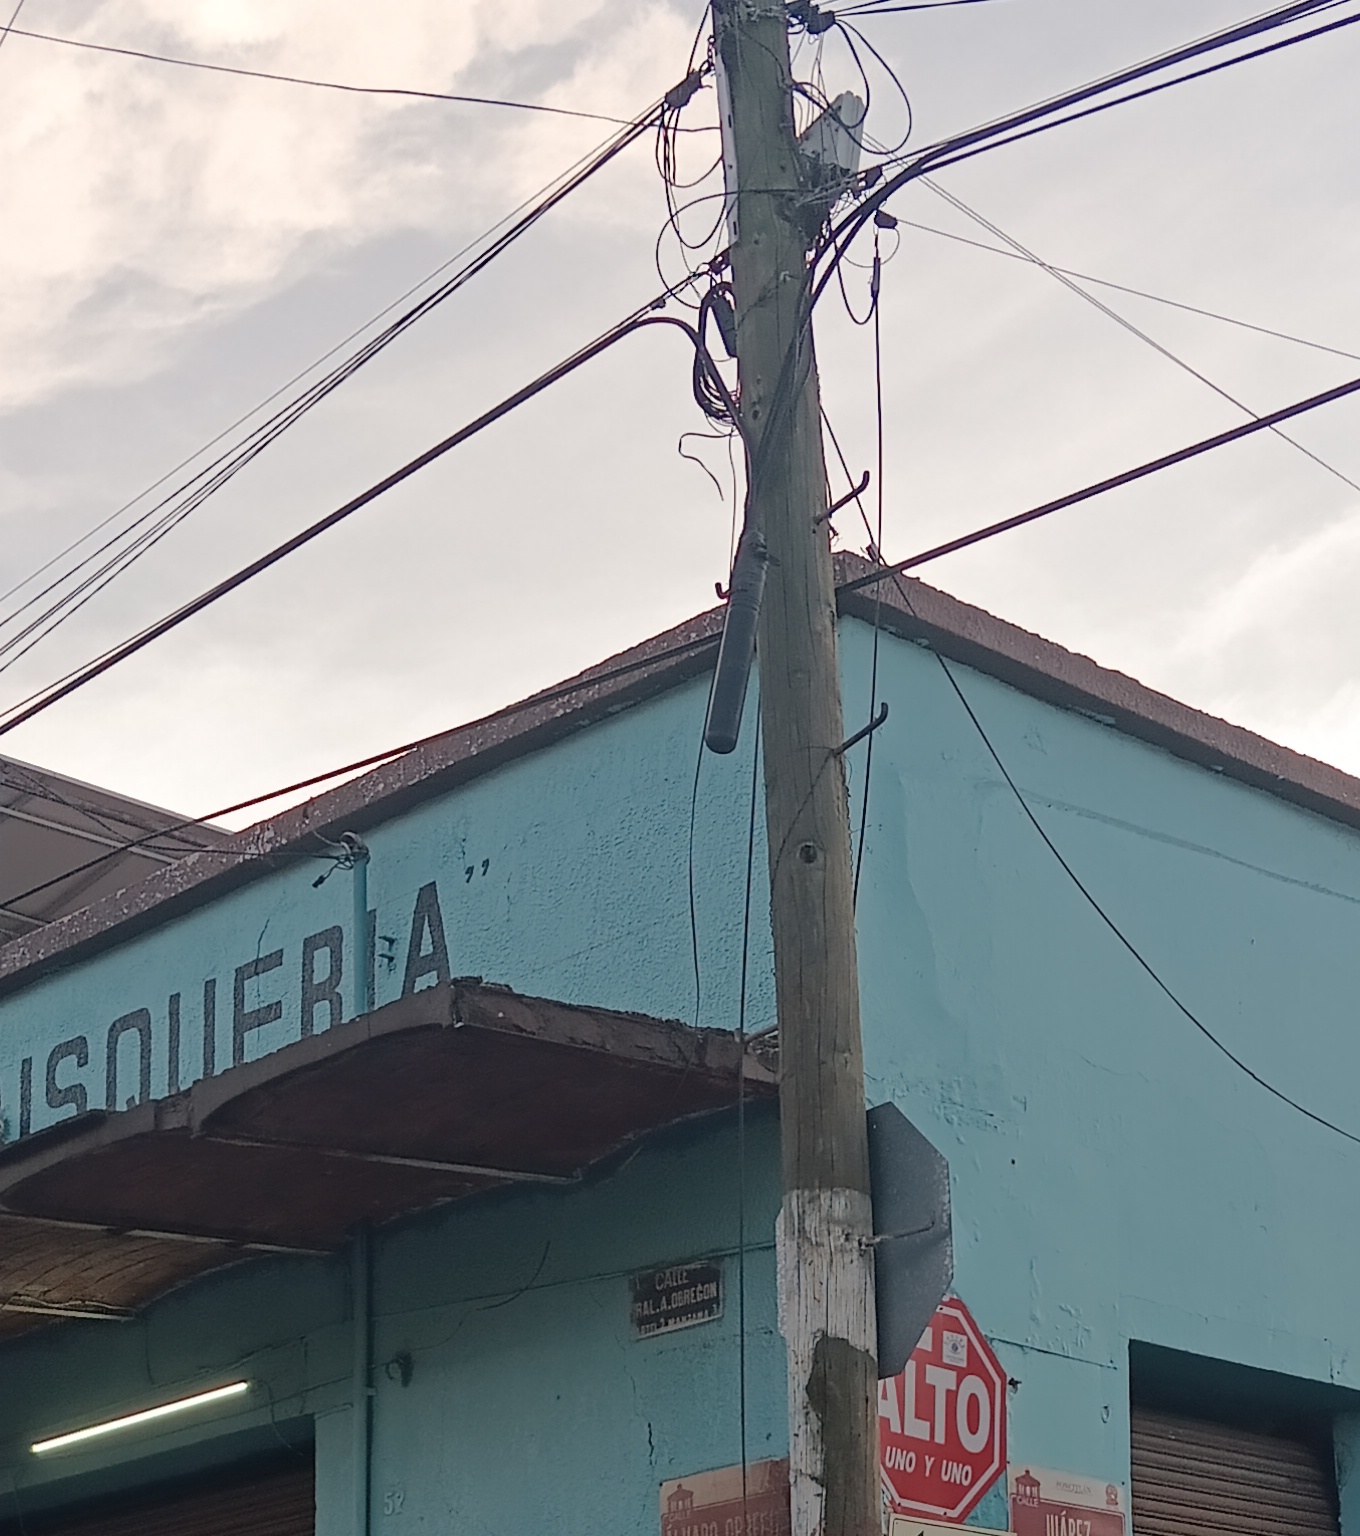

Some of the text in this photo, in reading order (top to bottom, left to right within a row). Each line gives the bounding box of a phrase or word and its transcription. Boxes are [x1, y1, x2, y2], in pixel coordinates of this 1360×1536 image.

[884, 1446, 973, 1487] UNO Y UNO
[1016, 1494, 1040, 1509] CALLE
